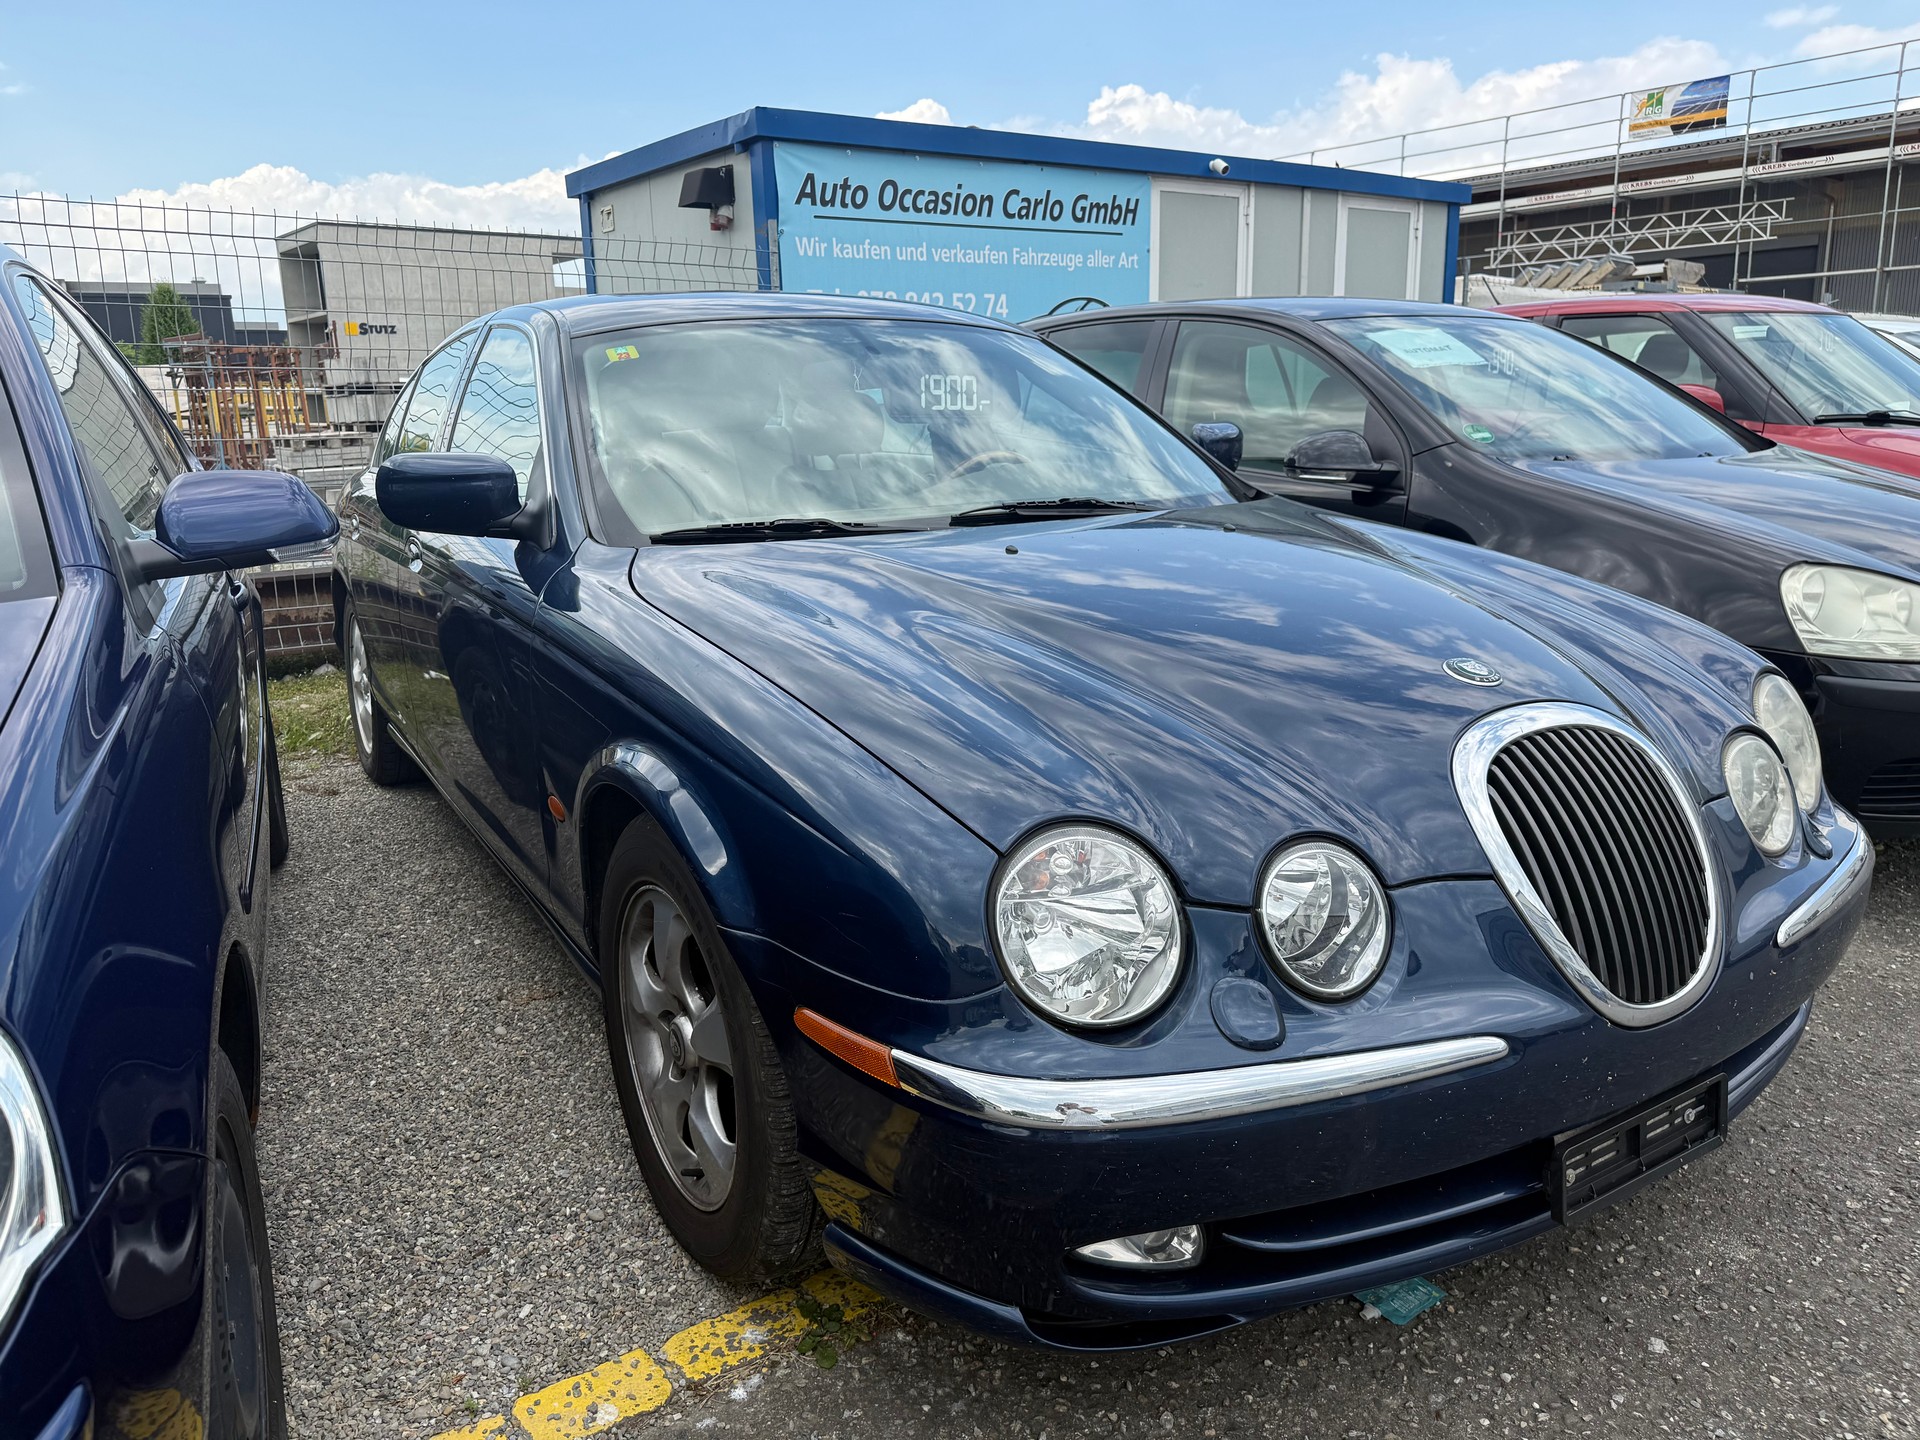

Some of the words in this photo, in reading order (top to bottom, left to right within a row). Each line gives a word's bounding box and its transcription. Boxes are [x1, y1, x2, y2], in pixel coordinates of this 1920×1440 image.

[1762, 163, 1787, 171] KREBS
[1630, 181, 1653, 189] KREBS
[795, 172, 869, 210] Auto
[878, 179, 994, 217] Occasion
[1002, 188, 1064, 222] Carlo
[1071, 194, 1140, 226] GmbH
[795, 236, 827, 257] Wir
[832, 237, 891, 260] kaufen
[896, 242, 927, 262] und
[932, 243, 1008, 265] verkaufen
[1012, 247, 1083, 272] Fahrzeuge
[1087, 250, 1115, 268] aller
[1118, 251, 1139, 269] Art
[952, 292, 976, 313] 52
[984, 293, 1008, 318] 74
